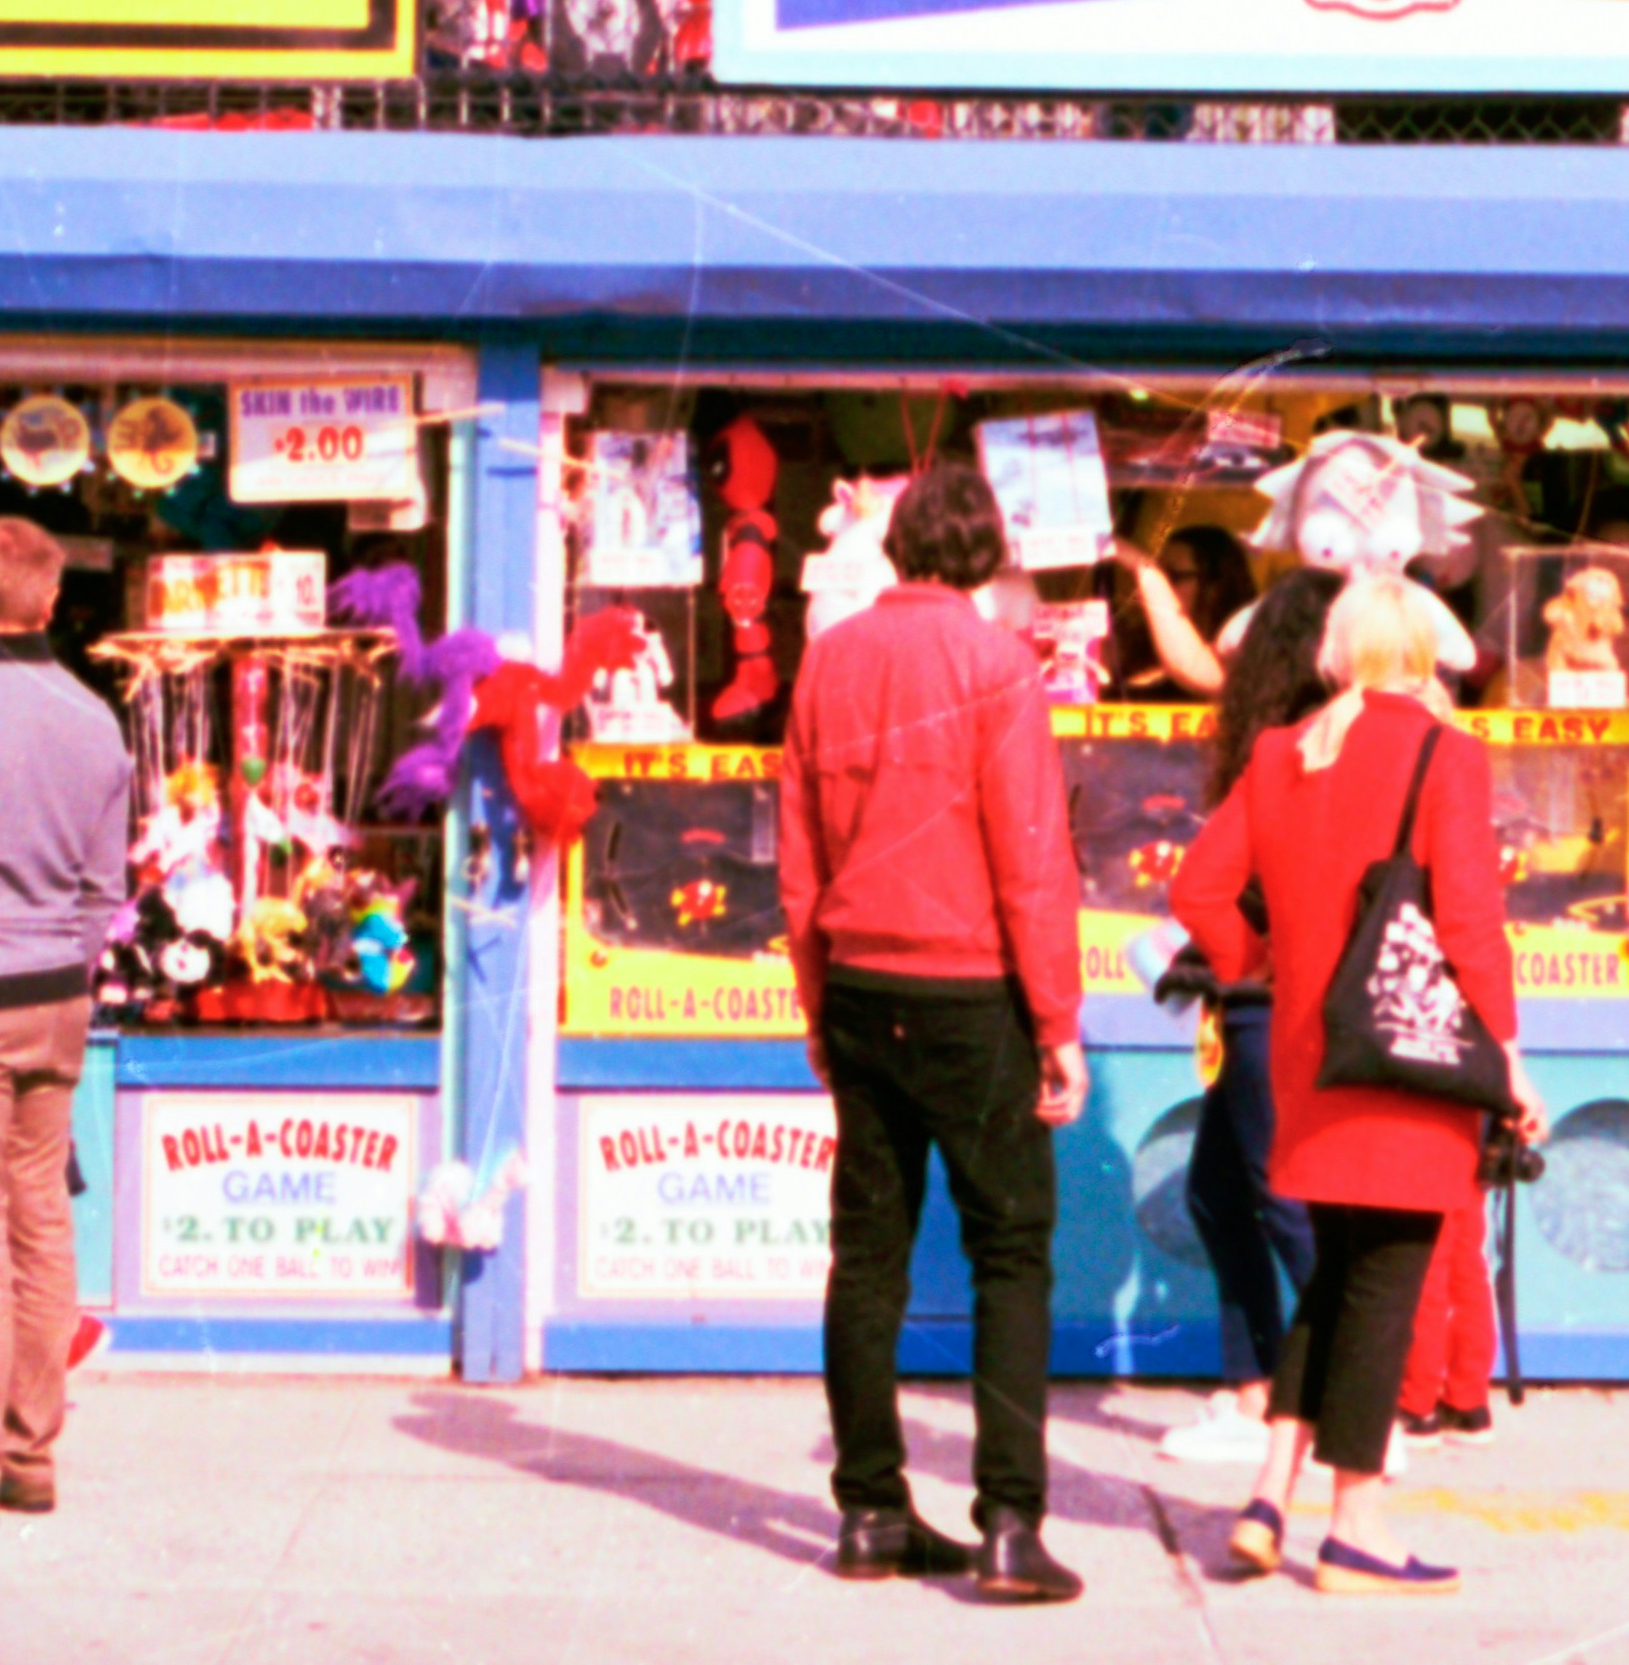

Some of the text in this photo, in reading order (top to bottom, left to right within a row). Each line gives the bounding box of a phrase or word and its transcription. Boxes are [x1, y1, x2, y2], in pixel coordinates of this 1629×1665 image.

[241, 385, 399, 416] SKIN the WIRE
[1172, 711, 1217, 739] EA
[1513, 716, 1610, 742] EASY
[624, 750, 782, 778] IT'S EAS
[1516, 952, 1619, 986] COASTER
[610, 987, 800, 1021] ROLL-A-COASTE
[162, 1118, 398, 1173] ROLL-A-COASTER
[599, 1119, 837, 1173] ROLL-A-COASTER
[222, 1170, 337, 1204] GAME
[657, 1171, 770, 1205] GAME
[224, 1216, 275, 1243] TO
[294, 1216, 394, 1244] PLAY
[665, 1216, 715, 1245] TO
[159, 1254, 218, 1279] CATCH
[227, 1254, 266, 1278] ONE
[275, 1254, 319, 1279] BALL
[330, 1255, 353, 1278] TO
[595, 1256, 657, 1280] CATCH
[663, 1256, 702, 1280] ONE
[712, 1256, 755, 1281] BALL
[768, 1256, 790, 1280] TO
